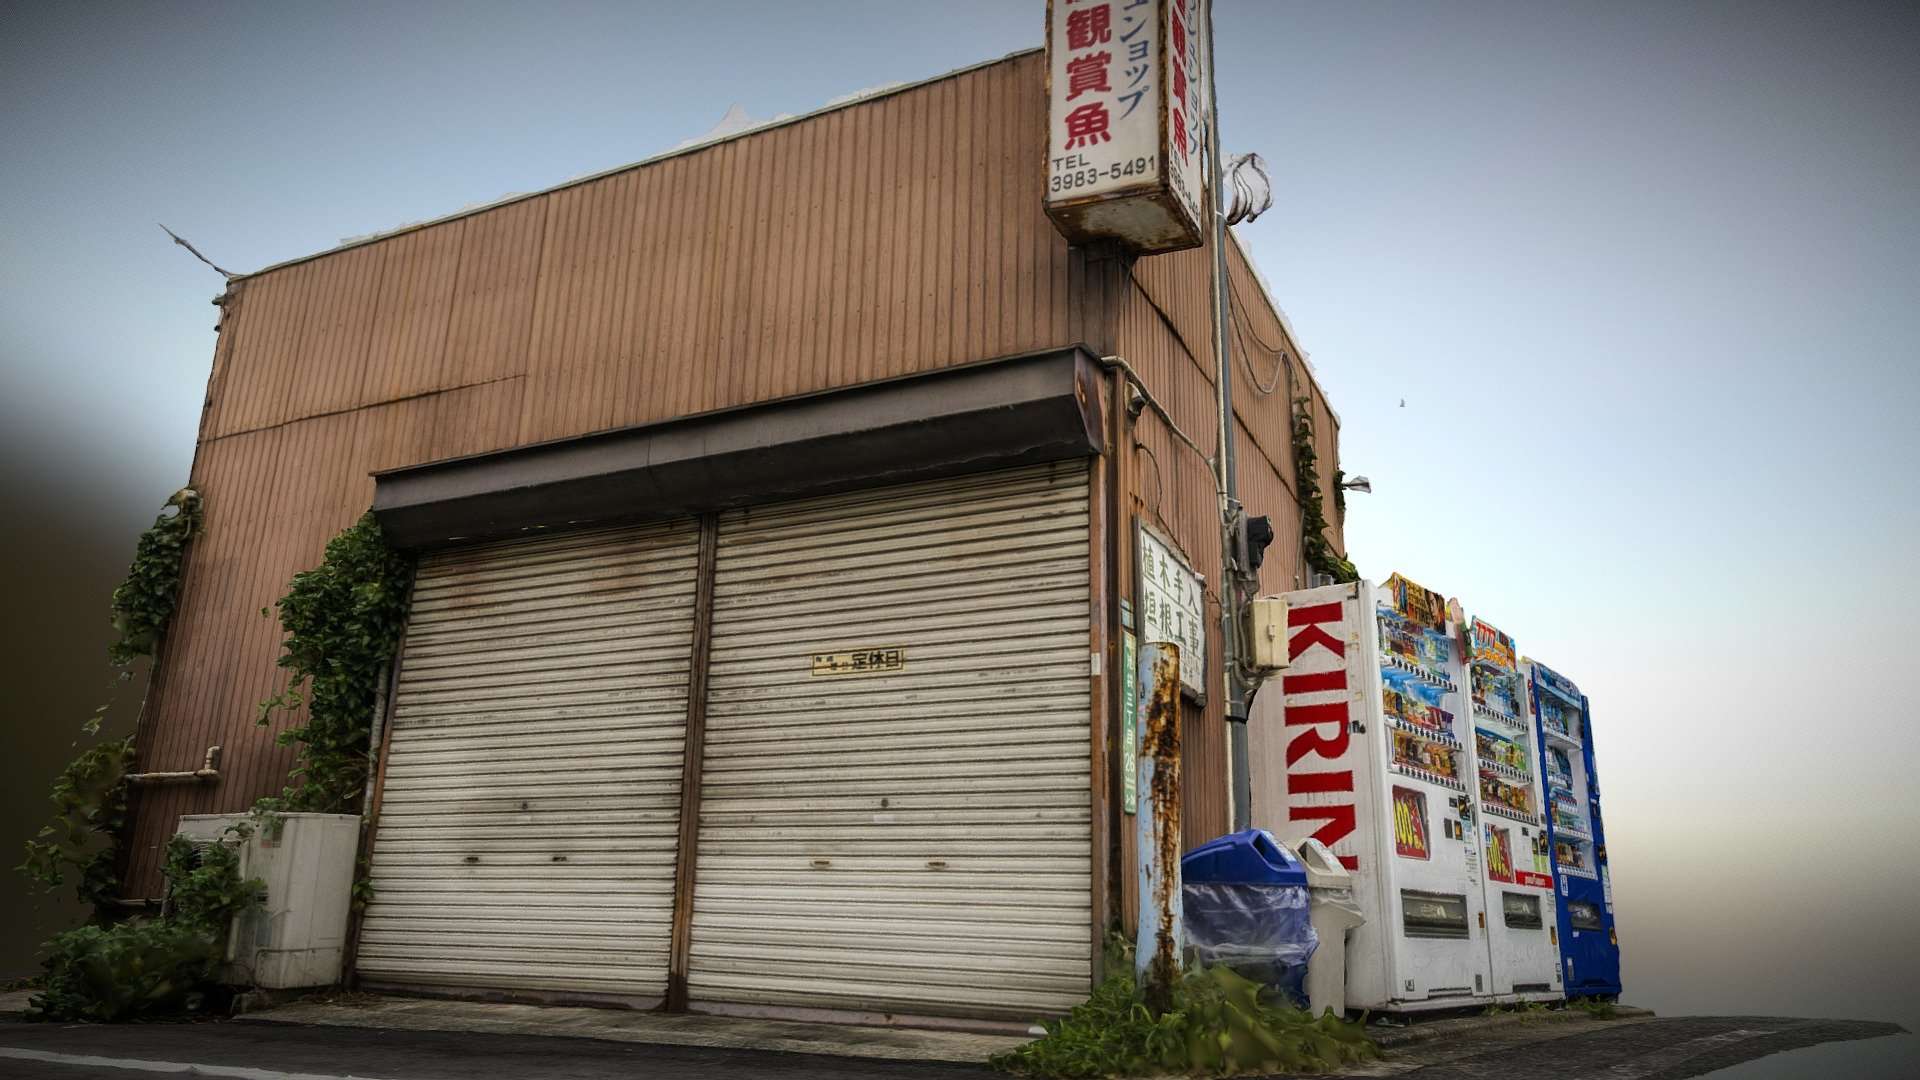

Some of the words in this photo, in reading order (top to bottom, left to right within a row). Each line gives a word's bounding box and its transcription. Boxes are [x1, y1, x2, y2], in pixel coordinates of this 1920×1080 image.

[1051, 155, 1155, 192] 3983-5491
[1052, 153, 1091, 171] TEL
[852, 650, 899, 669] 定休日
[1282, 600, 1359, 871] KIRIN
